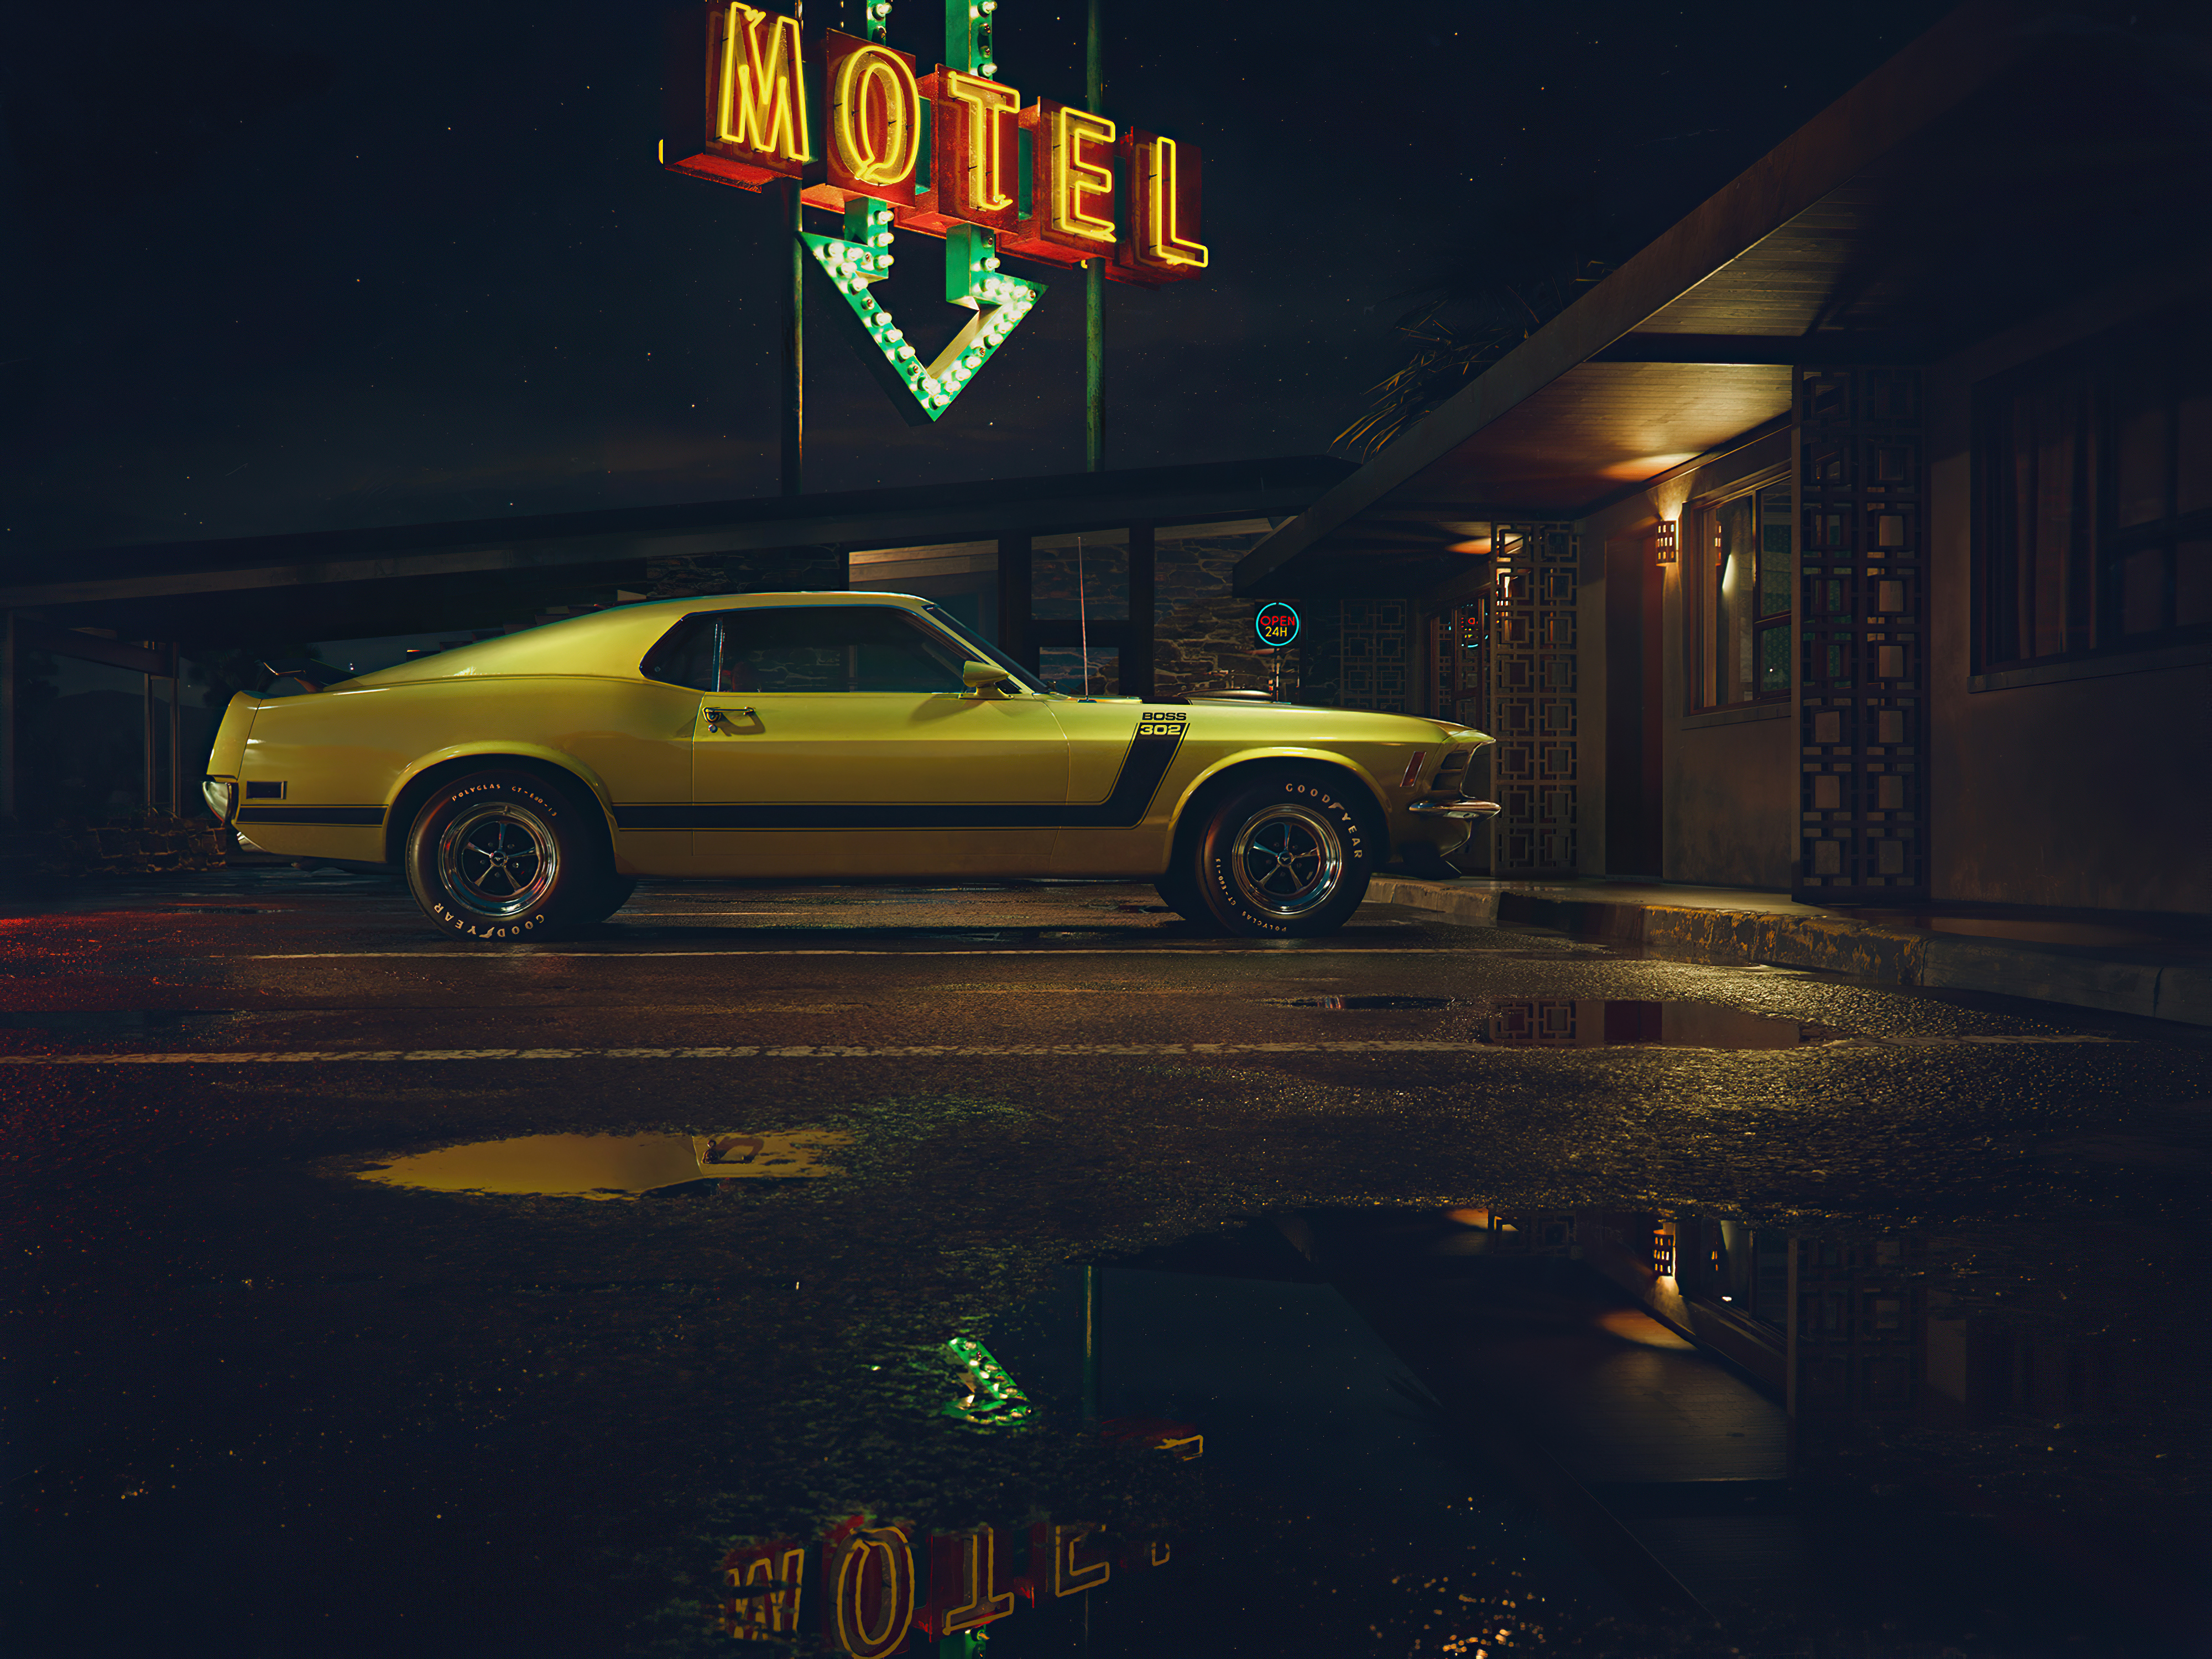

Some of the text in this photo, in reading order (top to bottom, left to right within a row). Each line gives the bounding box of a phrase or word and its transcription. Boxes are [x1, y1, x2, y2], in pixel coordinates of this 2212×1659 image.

[716, 2, 1208, 268] MOTEL
[1260, 615, 1295, 626] OPEN
[1265, 626, 1287, 637] 24H
[1141, 712, 1187, 721] BOSS
[1139, 724, 1181, 735] 302
[451, 783, 501, 802] POLYGLAS
[1285, 783, 1363, 858] GOODYEAR
[434, 902, 545, 938] GOODYEAR
